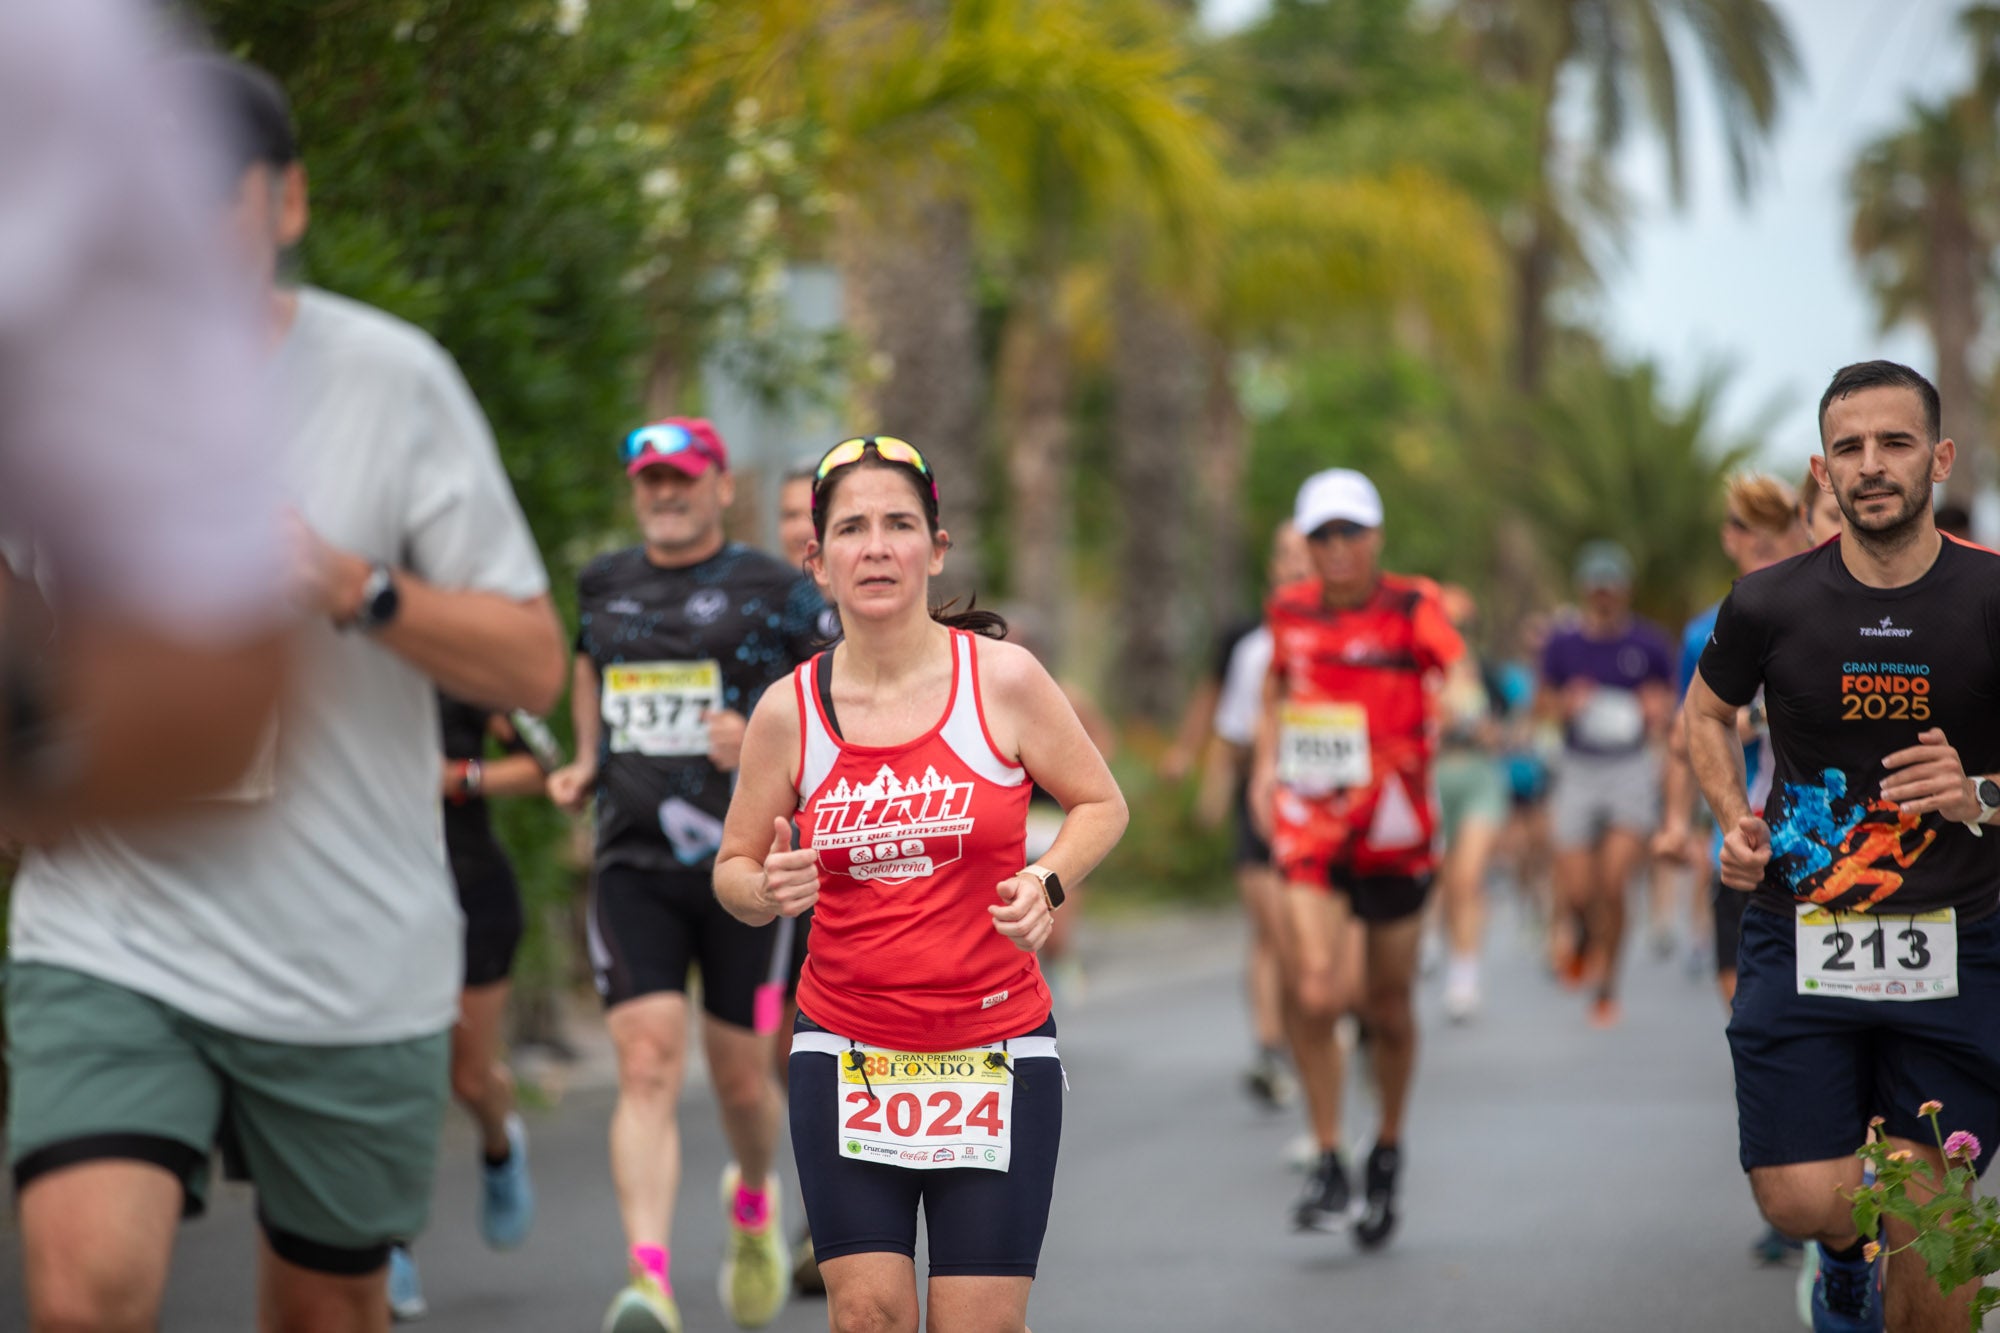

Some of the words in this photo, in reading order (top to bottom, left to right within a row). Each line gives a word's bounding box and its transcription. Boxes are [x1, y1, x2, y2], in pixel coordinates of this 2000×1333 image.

[1859, 627, 1913, 637] TEAMERGY
[1842, 662, 1878, 673] GRAN
[1881, 662, 1930, 675] PREMIO
[1841, 675, 1930, 695] FONDO
[1841, 694, 1931, 721] 2025
[867, 830, 893, 841] QUE
[858, 861, 926, 878] Salobreña
[1821, 929, 1931, 971] 213
[864, 1056, 889, 1077] 38
[890, 1062, 975, 1077] FONDO
[845, 1091, 1004, 1137] 2024
[863, 1144, 898, 1155] Cruzcampo
